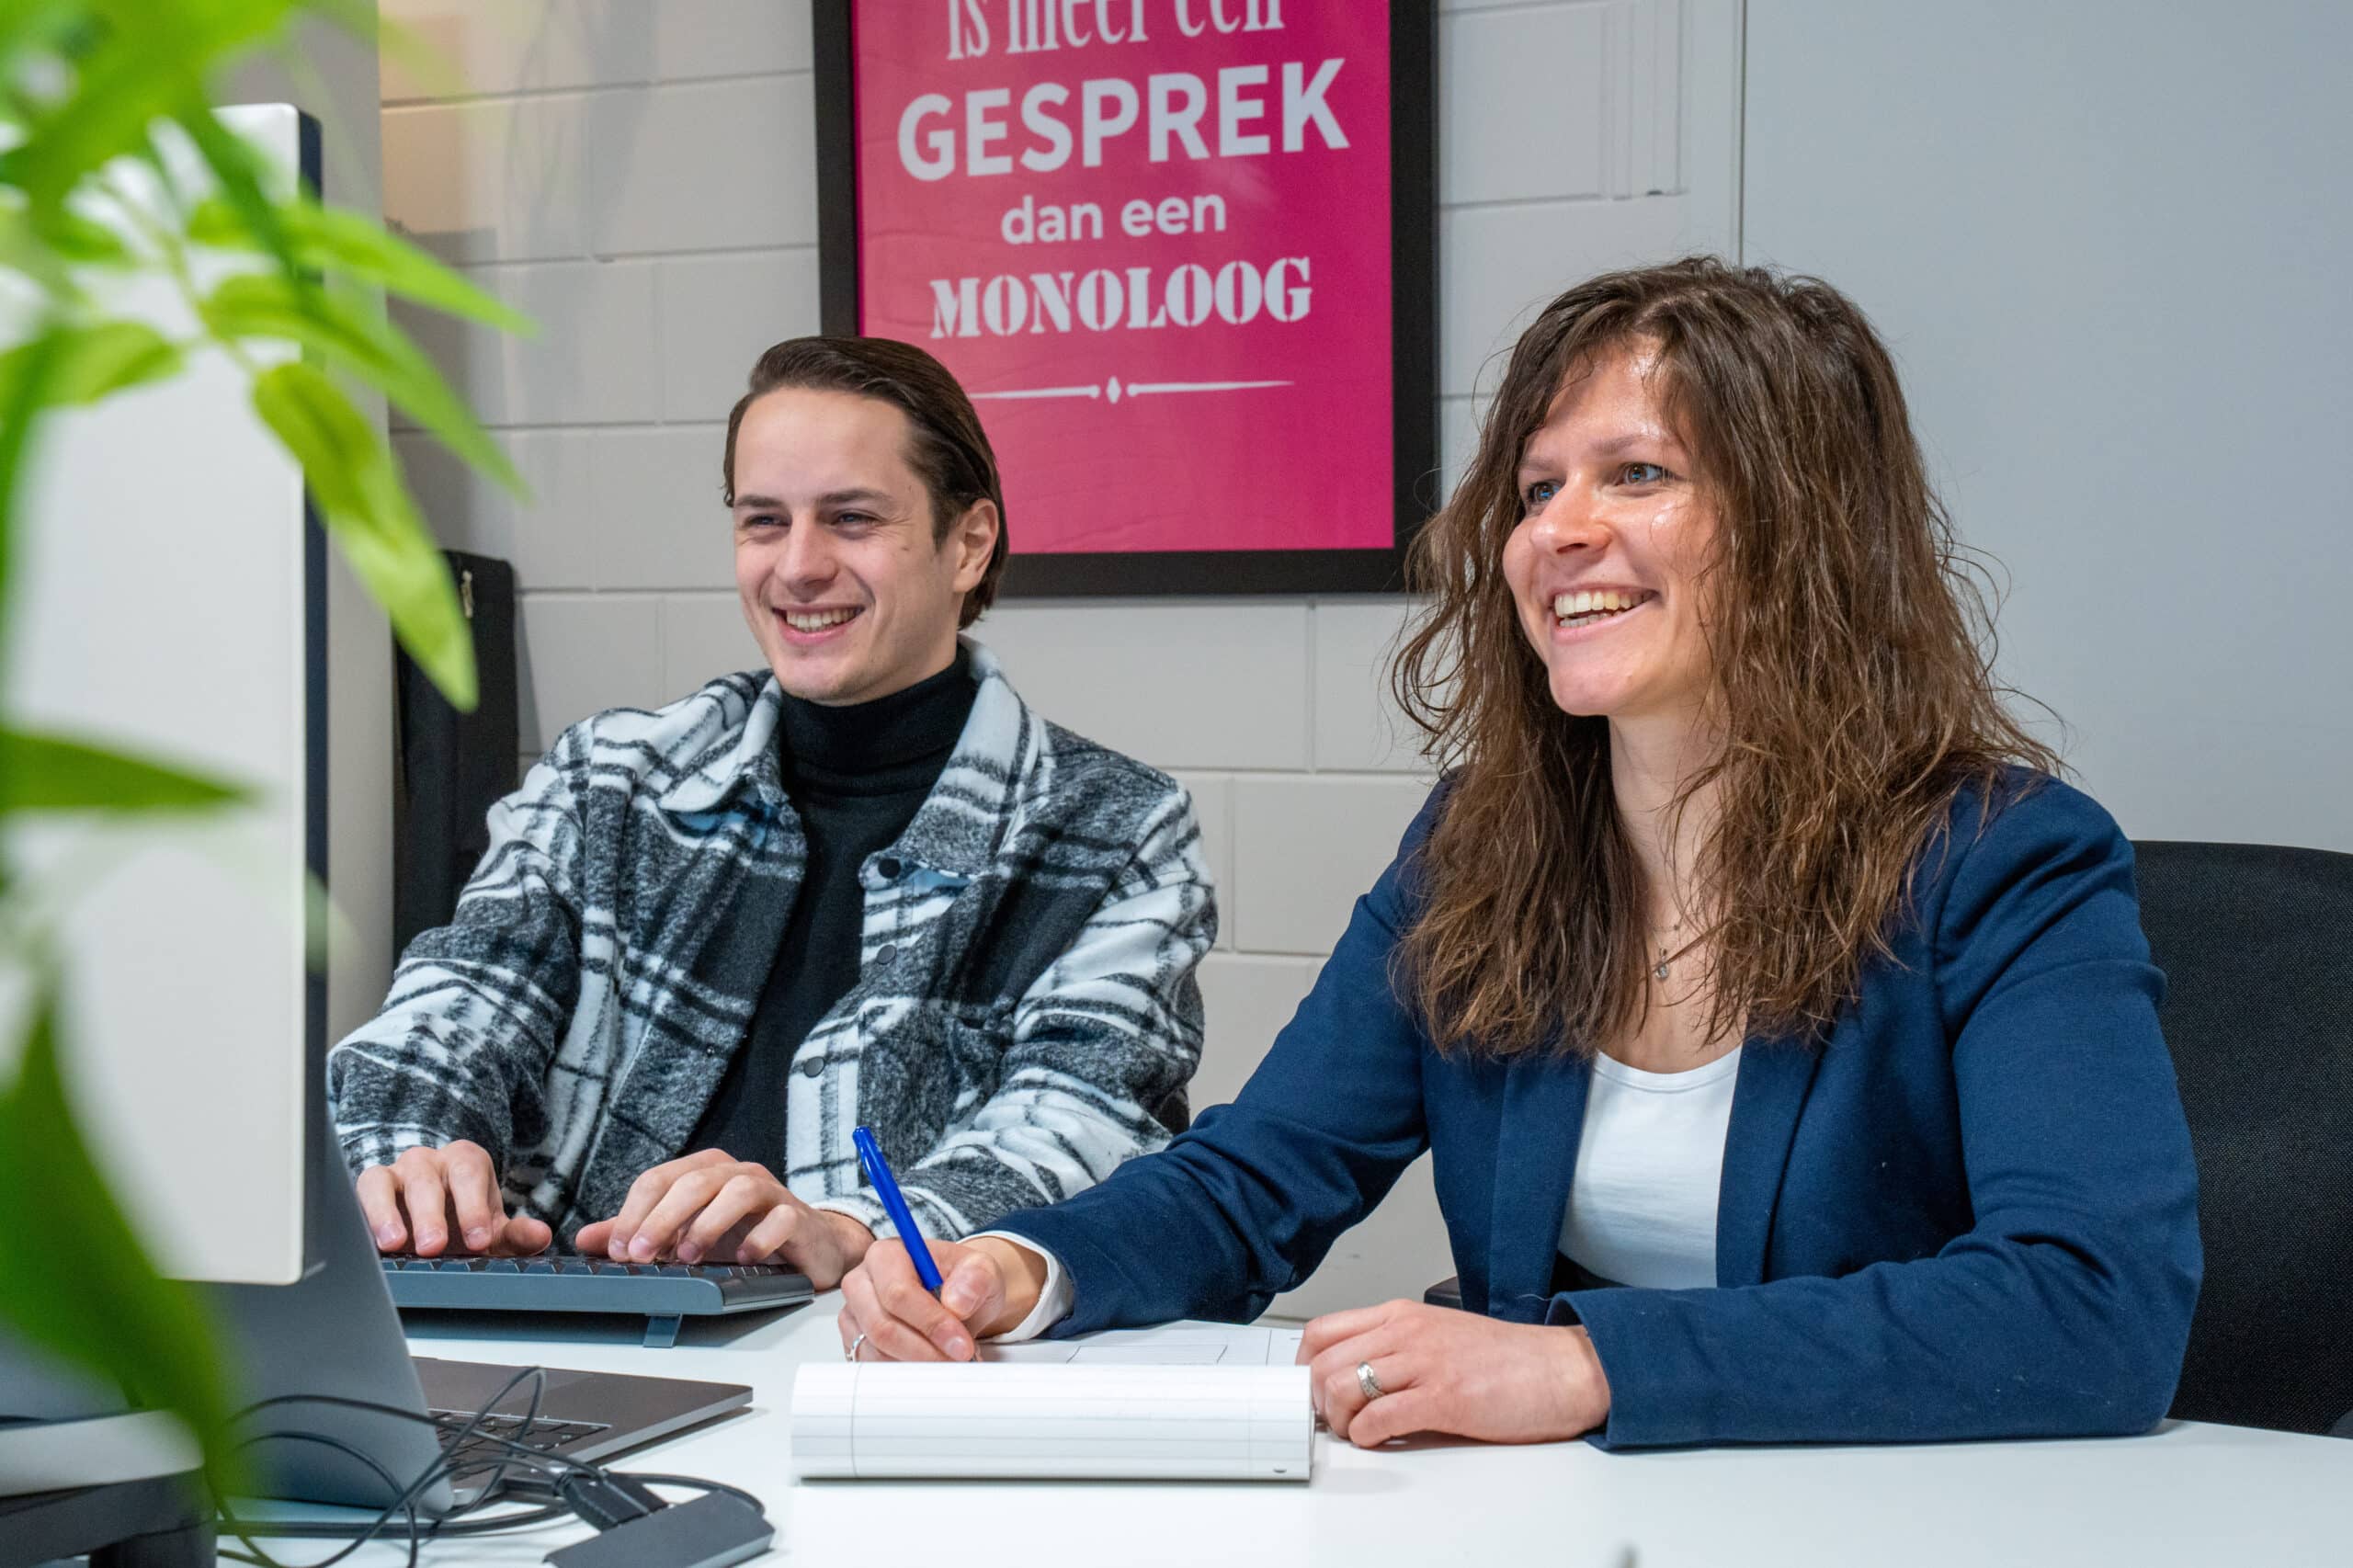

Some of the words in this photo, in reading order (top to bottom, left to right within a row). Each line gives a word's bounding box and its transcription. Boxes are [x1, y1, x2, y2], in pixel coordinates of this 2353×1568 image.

[897, 58, 1350, 181] GESPREK
[1001, 195, 1103, 245] dan
[1120, 194, 1226, 237] een
[929, 256, 1312, 339] MONOLOOG
